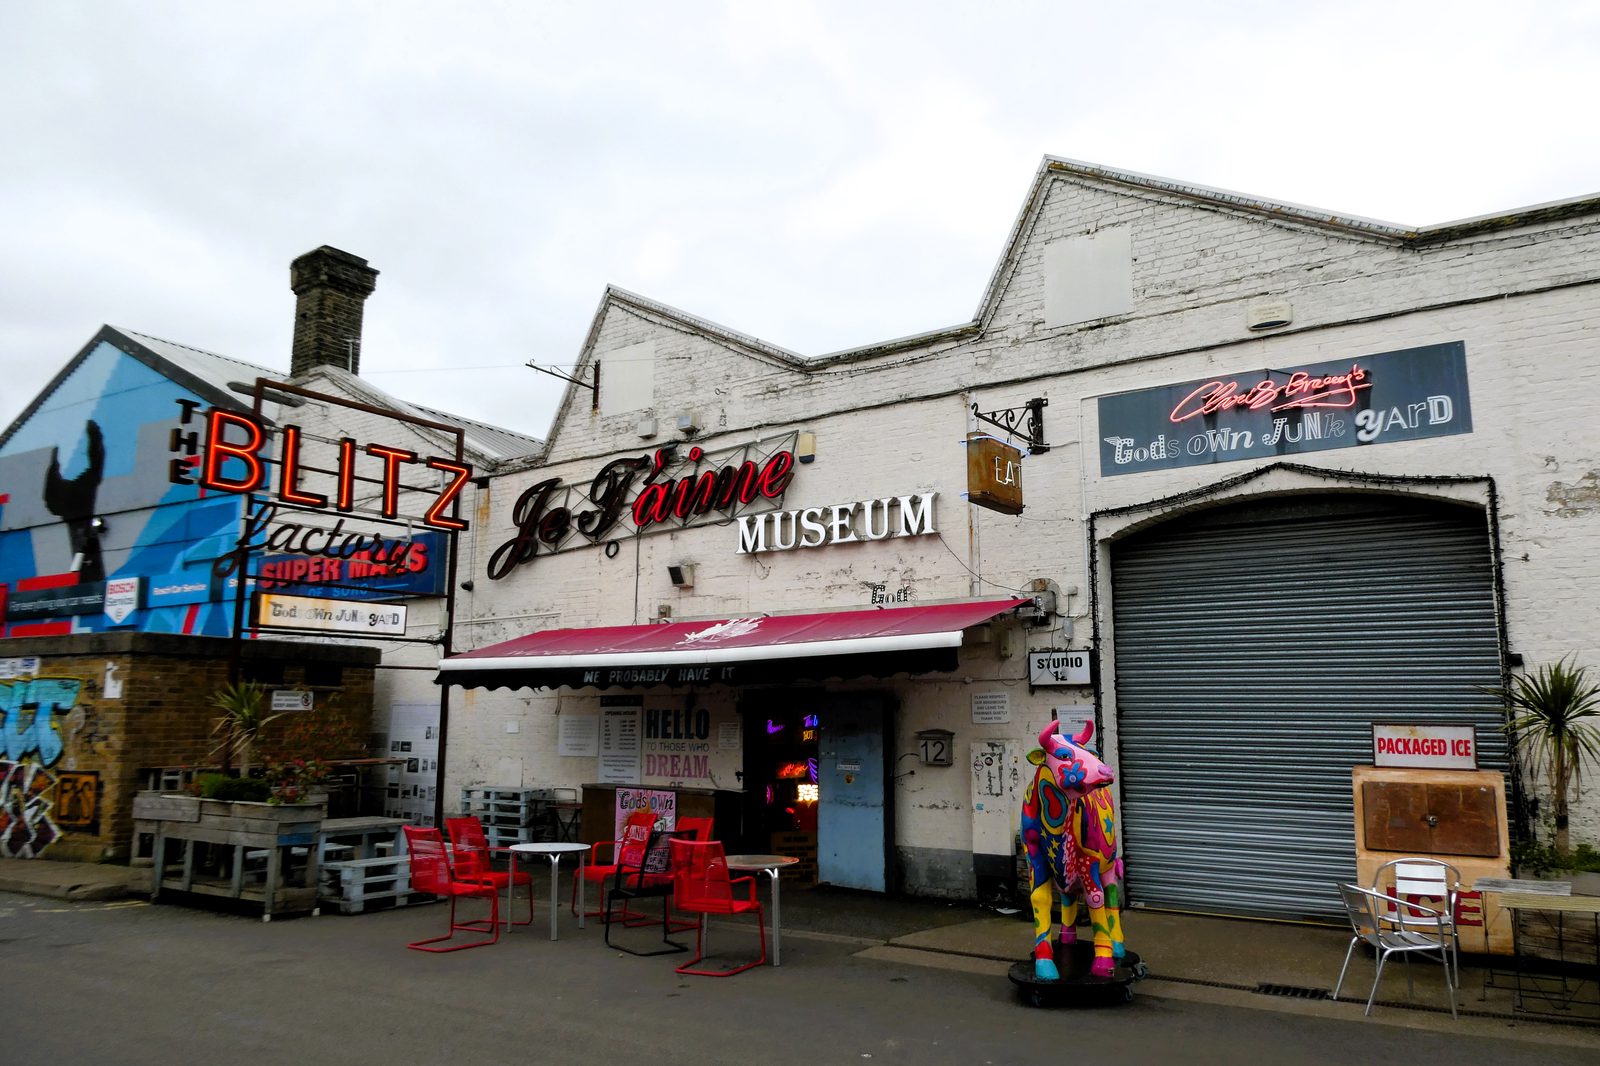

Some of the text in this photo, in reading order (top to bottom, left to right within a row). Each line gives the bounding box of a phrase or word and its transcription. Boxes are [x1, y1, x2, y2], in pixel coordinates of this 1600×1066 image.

[1104, 434, 1179, 465] Gods
[170, 398, 473, 531] THE BLITZ
[487, 477, 572, 580] Je
[736, 491, 940, 555] MUSEUM
[212, 501, 414, 579] factory
[260, 557, 342, 590] SUPER
[271, 601, 298, 618] God
[583, 666, 735, 683] WE PROBABLY HAVE IT
[1037, 656, 1083, 669] STUDIO
[1053, 670, 1068, 682] 12
[646, 708, 711, 740] HELLO
[647, 742, 710, 752] TO THOSE WHO
[920, 740, 945, 762] 12
[1377, 737, 1471, 757] PACKAGED ICE
[645, 753, 710, 779] DREAM
[1386, 884, 1482, 927] ICE
